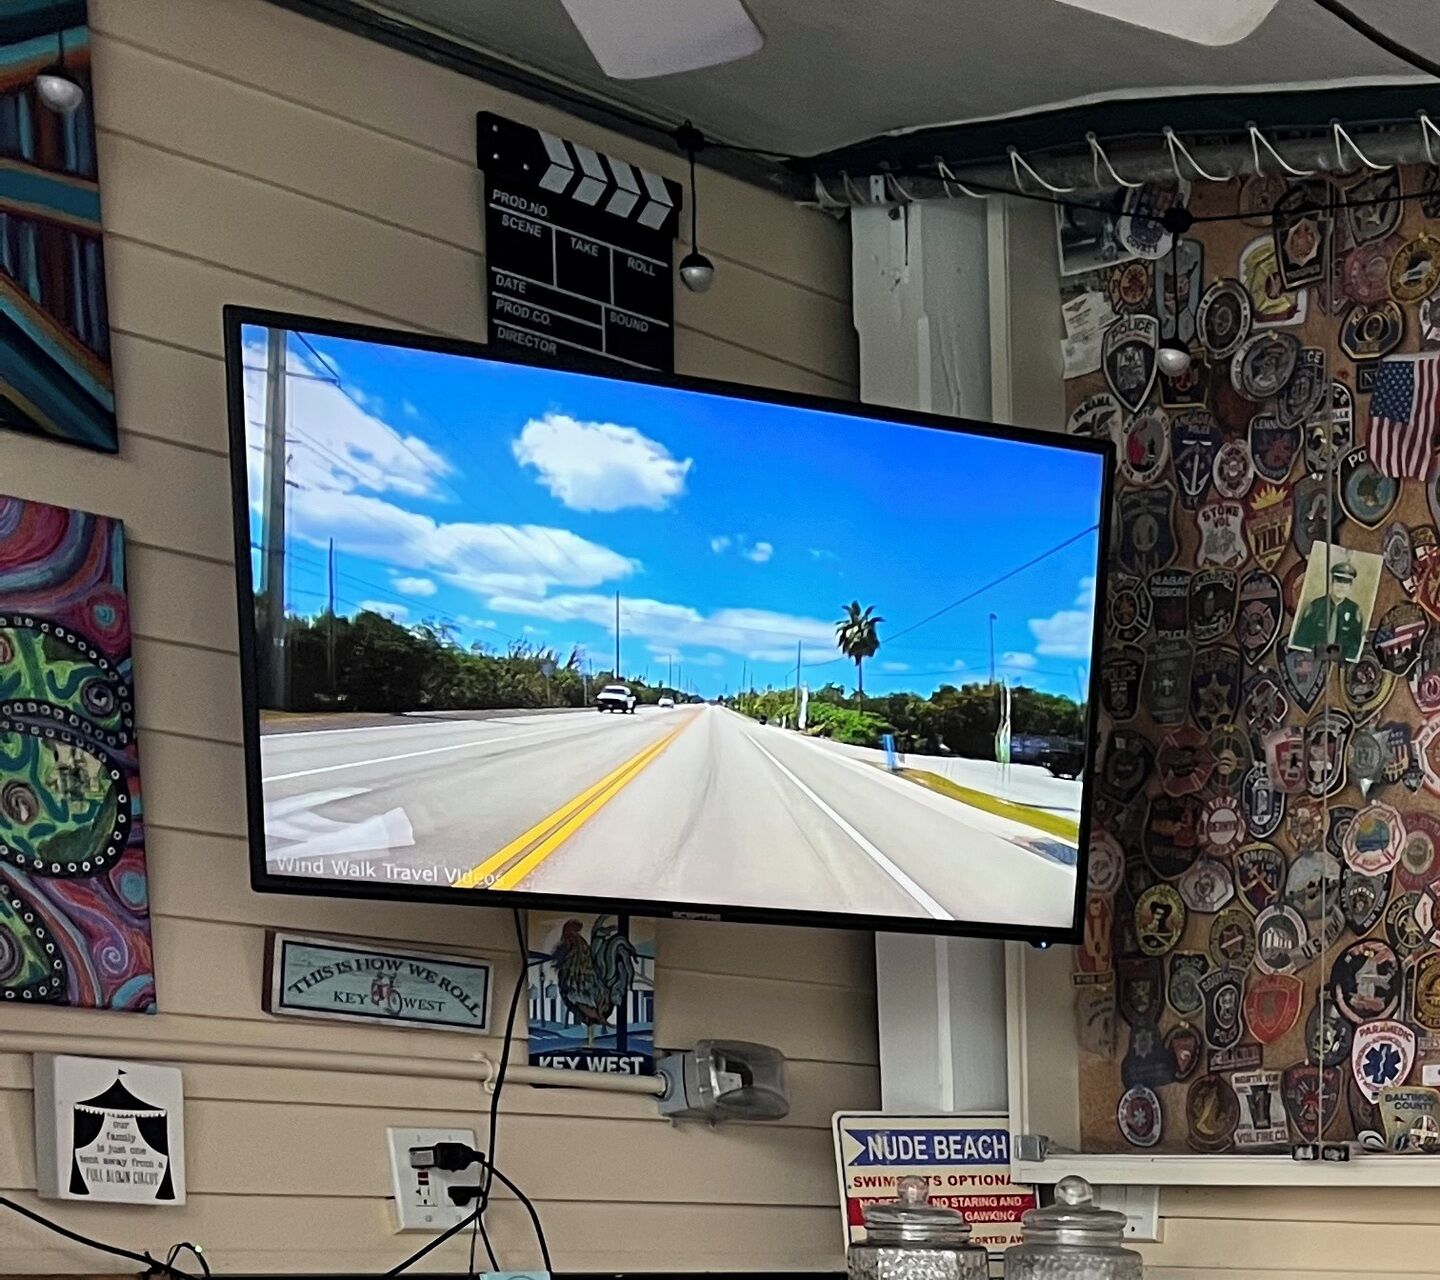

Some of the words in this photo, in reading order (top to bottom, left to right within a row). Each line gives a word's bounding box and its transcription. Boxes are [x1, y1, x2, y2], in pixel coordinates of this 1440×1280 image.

[501, 214, 541, 237] SCENE
[570, 236, 599, 257] TAKE
[627, 256, 656, 277] ROLL
[495, 274, 527, 294] DATE
[610, 311, 649, 333] SOUND
[1112, 320, 1153, 339] POLICE
[497, 327, 557, 356] DIRECTOR
[275, 854, 324, 876] Wind
[333, 859, 377, 880] Walk
[383, 863, 439, 884] Travel
[445, 865, 506, 888] Videos
[287, 965, 334, 996] THIS
[335, 959, 355, 977] IS
[355, 957, 405, 974] HOW
[407, 962, 440, 986] WE
[437, 972, 484, 1020] ROLL
[333, 990, 368, 1007] KEY
[402, 996, 447, 1015] WEST
[1359, 1025, 1414, 1043] PARAMEDIC
[538, 1055, 581, 1070] KEY
[585, 1056, 645, 1075] WEST
[1394, 1101, 1434, 1111] COUNTY
[106, 1132, 136, 1144] family
[1256, 1131, 1274, 1142] FIRE
[107, 1144, 126, 1155] just
[129, 1147, 147, 1155] one
[866, 1134, 929, 1162] NUDE
[933, 1133, 1008, 1160] BEACH
[79, 1155, 99, 1164] tent
[103, 1158, 127, 1168] away
[131, 1158, 154, 1168] from
[949, 1174, 1012, 1187] OPTIONA
[931, 1197, 950, 1208] NO
[950, 1196, 998, 1208] STARING
[999, 1196, 1023, 1207] AND
[964, 1210, 1016, 1222] GAWKING
